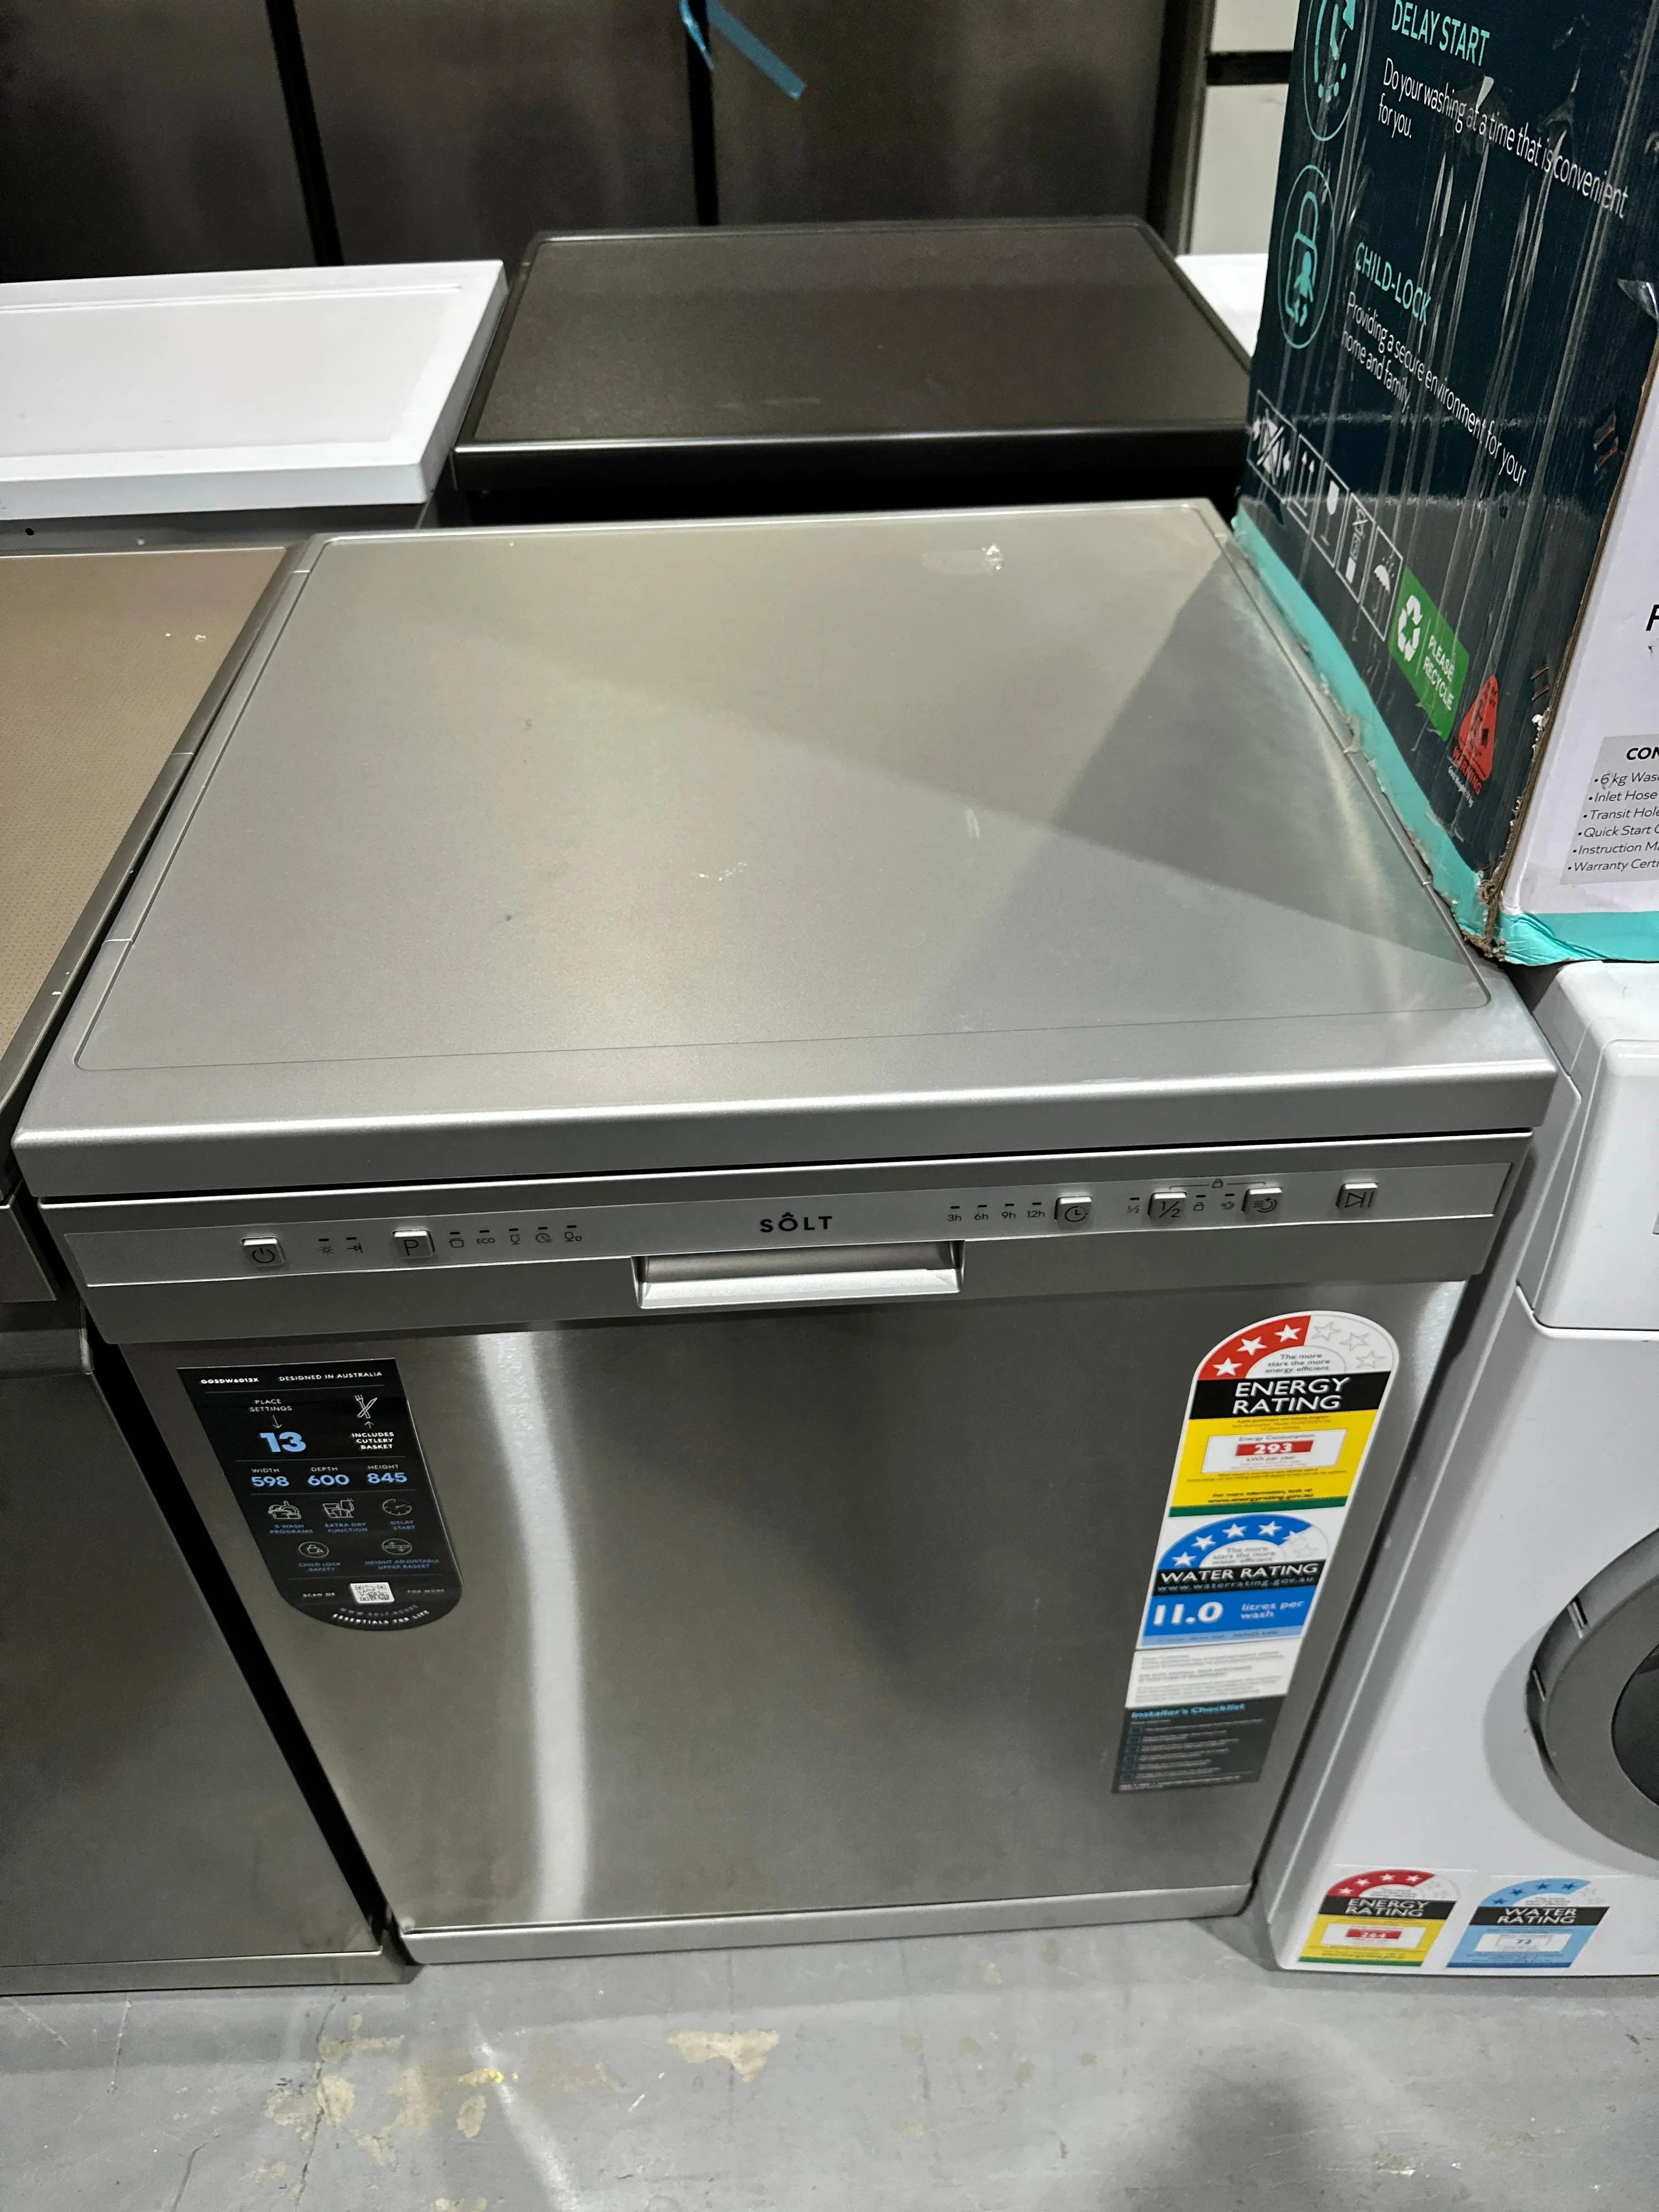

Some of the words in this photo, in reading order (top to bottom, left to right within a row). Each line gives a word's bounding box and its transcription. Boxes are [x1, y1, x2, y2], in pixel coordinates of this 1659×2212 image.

[1392, 0, 1440, 45] DELAY
[1440, 15, 1490, 66] START
[1378, 93, 1395, 126] for
[1391, 109, 1412, 138] you.
[1383, 58, 1399, 90] Do
[1398, 74, 1424, 101] your
[1424, 82, 1467, 133] washing
[1466, 107, 1480, 132] at
[1479, 114, 1488, 135] a
[1488, 111, 1515, 150] time
[1516, 122, 1542, 166] that
[1541, 138, 1554, 173] is
[1553, 154, 1629, 218] convenient
[1355, 242, 1432, 326] CHILD-LOCK
[1341, 320, 1367, 364] home
[1366, 353, 1386, 380] and
[1383, 360, 1411, 413] family.
[1347, 292, 1388, 354] Providing
[1387, 334, 1395, 353] a
[1394, 341, 1425, 381] secure
[1425, 370, 1487, 444] environment
[1485, 421, 1502, 459] for
[1498, 447, 1527, 486] your
[1428, 635, 1455, 682] PLEASE
[1423, 656, 1454, 711] RECYCLE
[1453, 746, 1481, 795] WARNING
[1600, 773, 1610, 785] 6
[1612, 772, 1628, 786] kg
[1632, 772, 1659, 783] Was
[1594, 791, 1622, 802] Inlet
[1624, 790, 1658, 801] Hose
[1590, 808, 1632, 820] Transit
[1584, 826, 1619, 838] Quick
[1621, 825, 1651, 836] Start
[1578, 843, 1641, 855] Instruction
[1574, 861, 1629, 872] Warranty
[759, 1212, 833, 1233] SÔLT
[947, 1213, 962, 1222] 3h
[974, 1212, 989, 1221] 6h
[1001, 1211, 1016, 1220] 9h
[1026, 1210, 1045, 1218] 12h
[402, 1239, 419, 1256] P
[476, 1237, 496, 1245] ECO
[337, 1371, 383, 1379] AUSTRALIA
[1235, 1377, 1351, 1397] ENERGY
[1233, 1395, 1342, 1414] RATING
[259, 1431, 307, 1453] 13
[1254, 1442, 1294, 1454] 293
[251, 1475, 290, 1487] 598
[307, 1474, 350, 1486] 600
[367, 1472, 408, 1484] 845
[1160, 1568, 1234, 1584] WATER
[1240, 1563, 1319, 1579] RATING
[1242, 1602, 1277, 1612] litres
[1280, 1600, 1305, 1610] per
[1153, 1601, 1224, 1627] 11.0
[1240, 1610, 1275, 1620] wash
[1348, 1898, 1430, 1910] ENERGY
[1345, 1906, 1425, 1917] RATING
[1504, 1908, 1577, 1916] WATER
[1496, 1915, 1577, 1924] RATING
